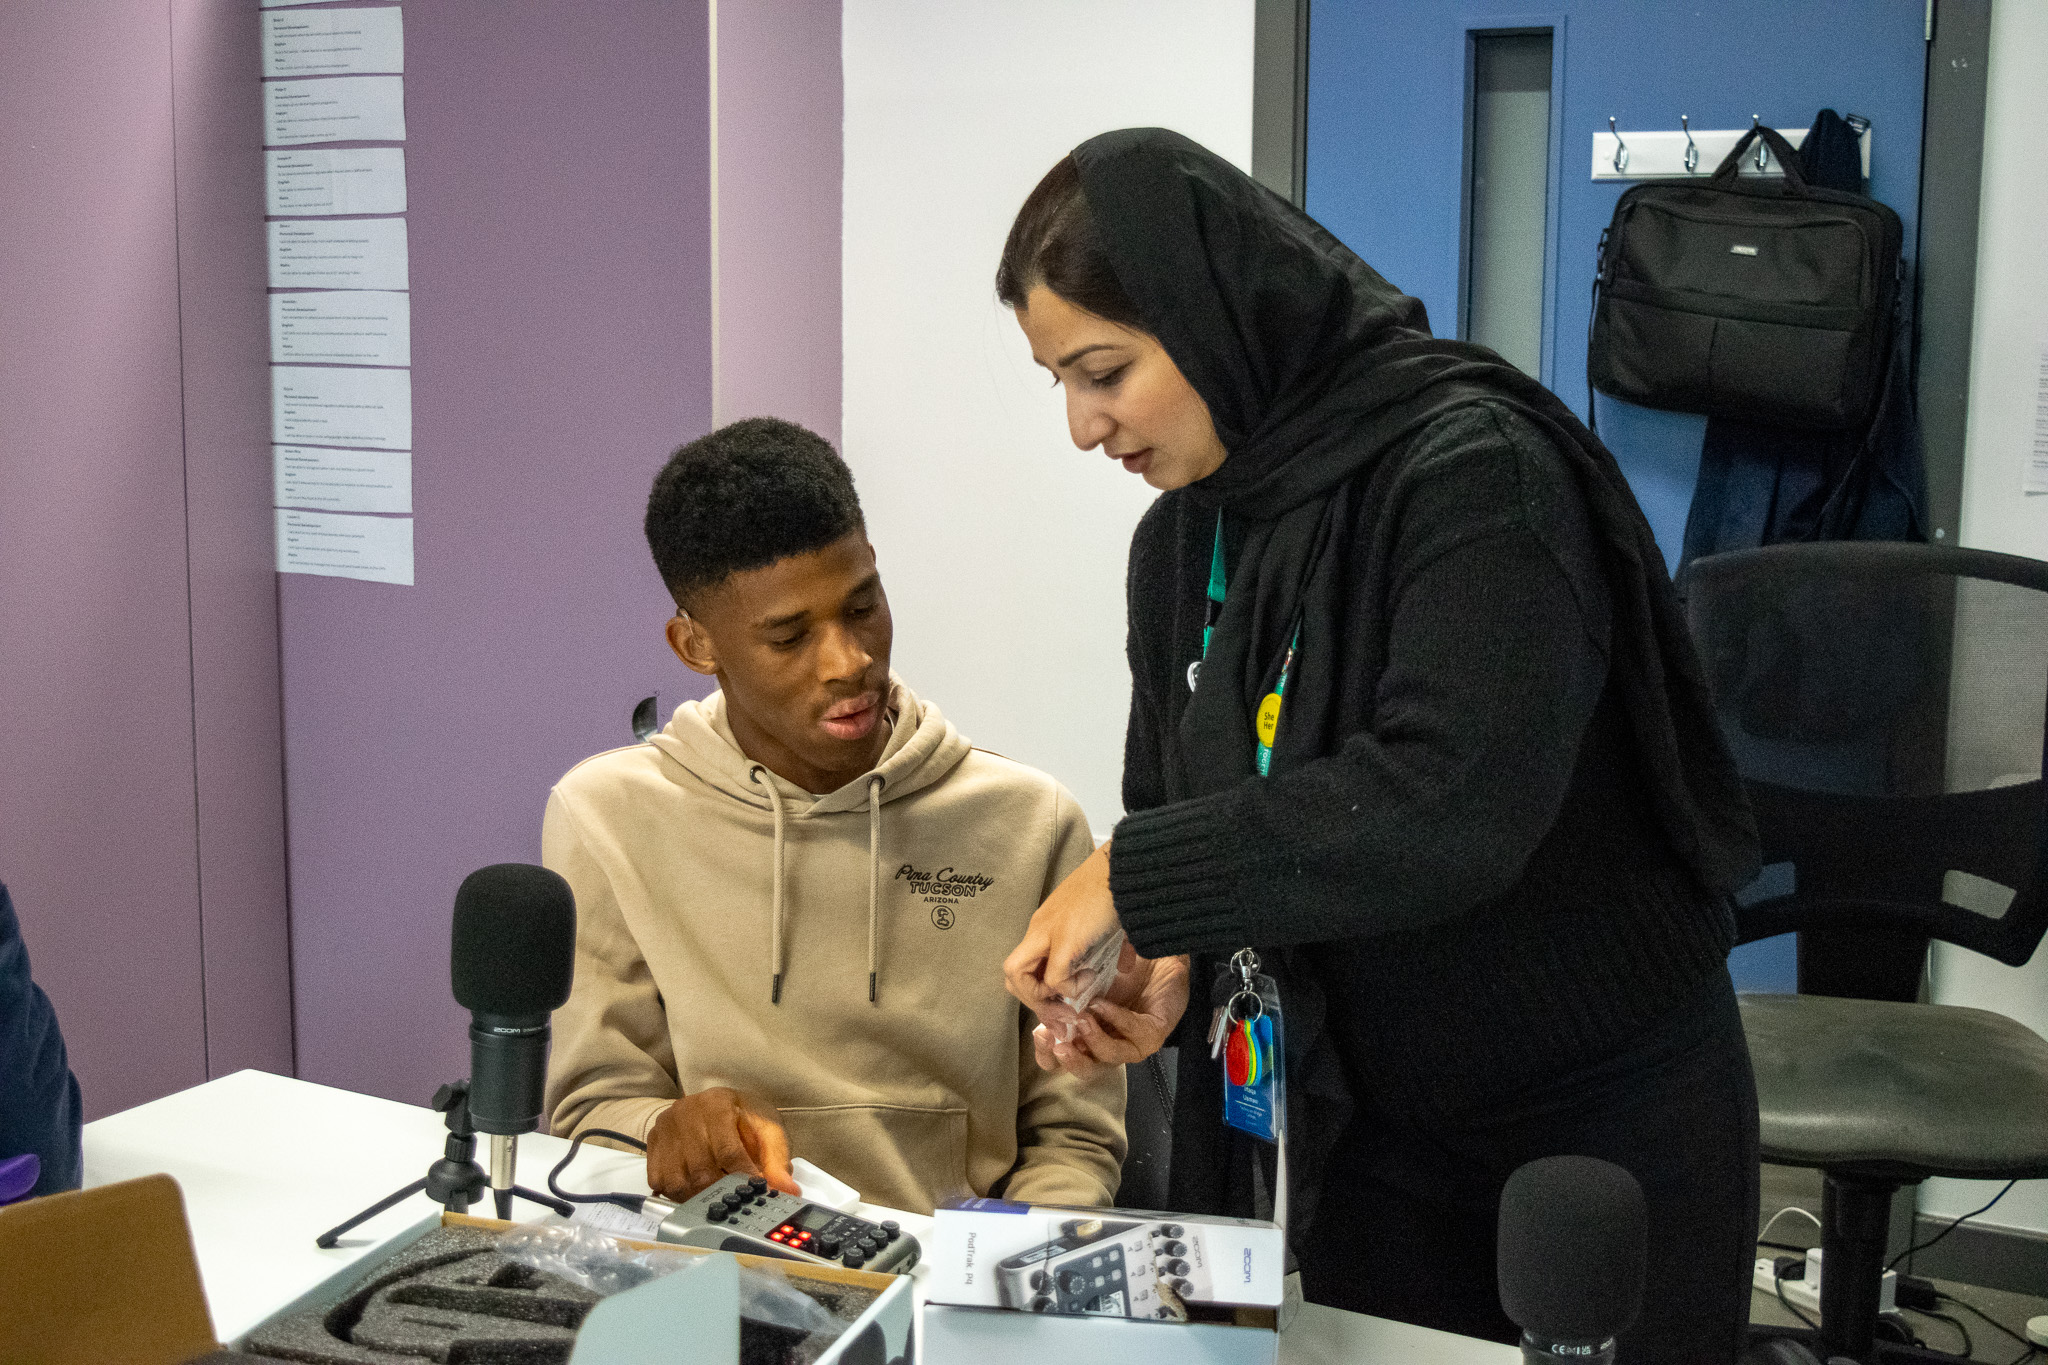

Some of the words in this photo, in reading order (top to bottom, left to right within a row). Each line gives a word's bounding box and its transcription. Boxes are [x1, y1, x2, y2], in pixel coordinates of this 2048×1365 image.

[1264, 712, 1274, 721] She
[1263, 721, 1274, 731] Her
[895, 864, 933, 881] Pima
[936, 867, 995, 892] Country
[910, 881, 977, 898] TUCSON
[923, 896, 960, 905] ARIZONA
[965, 1231, 977, 1268] PodTrak
[964, 1272, 974, 1285] P4
